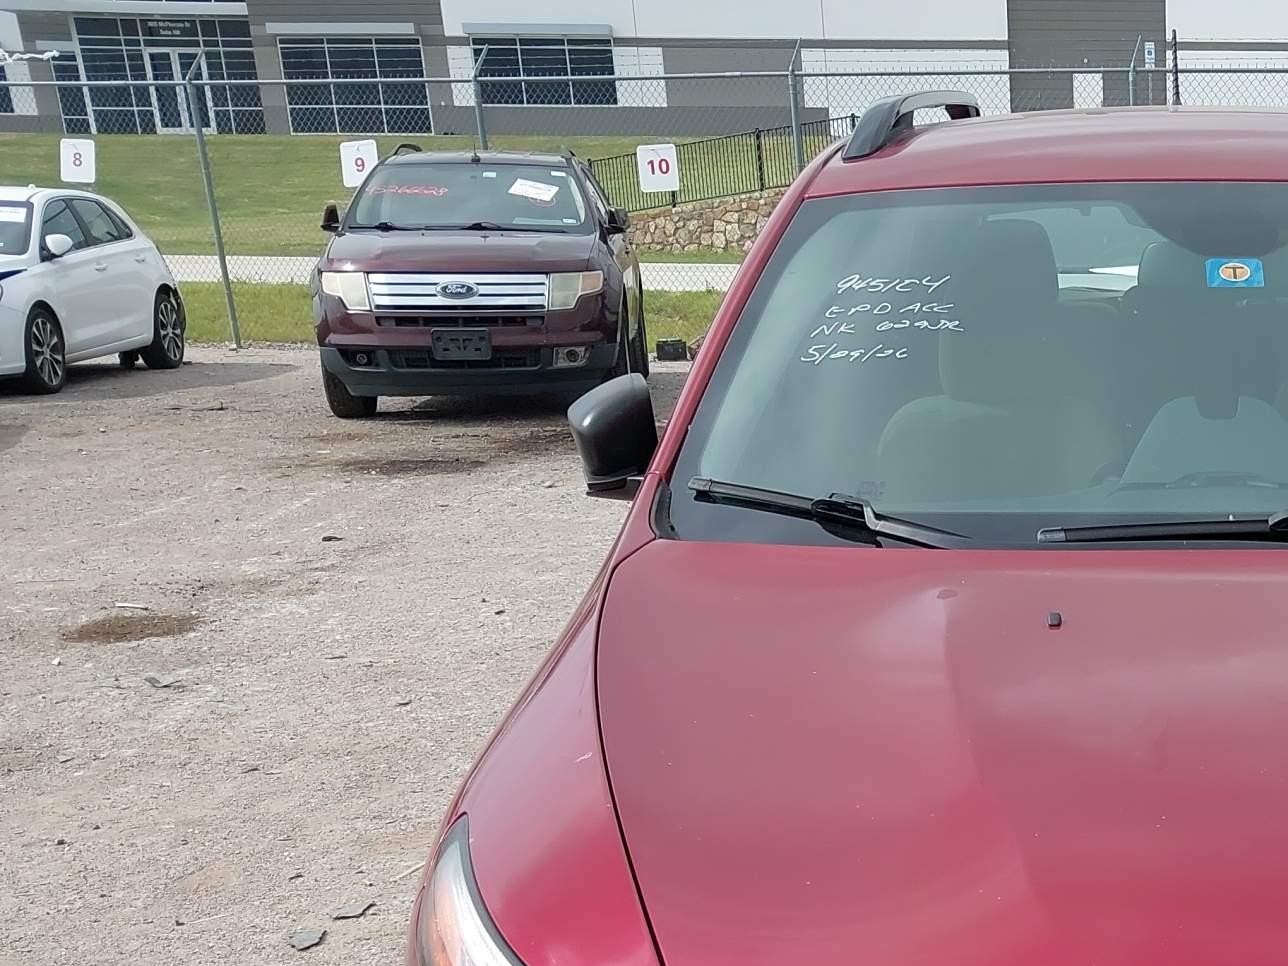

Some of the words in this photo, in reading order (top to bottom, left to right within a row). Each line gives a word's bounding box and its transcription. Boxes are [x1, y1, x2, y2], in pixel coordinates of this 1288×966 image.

[73, 152, 83, 167] 8
[354, 157, 366, 172] 9
[647, 158, 670, 175] 10
[445, 284, 468, 294] Ford
